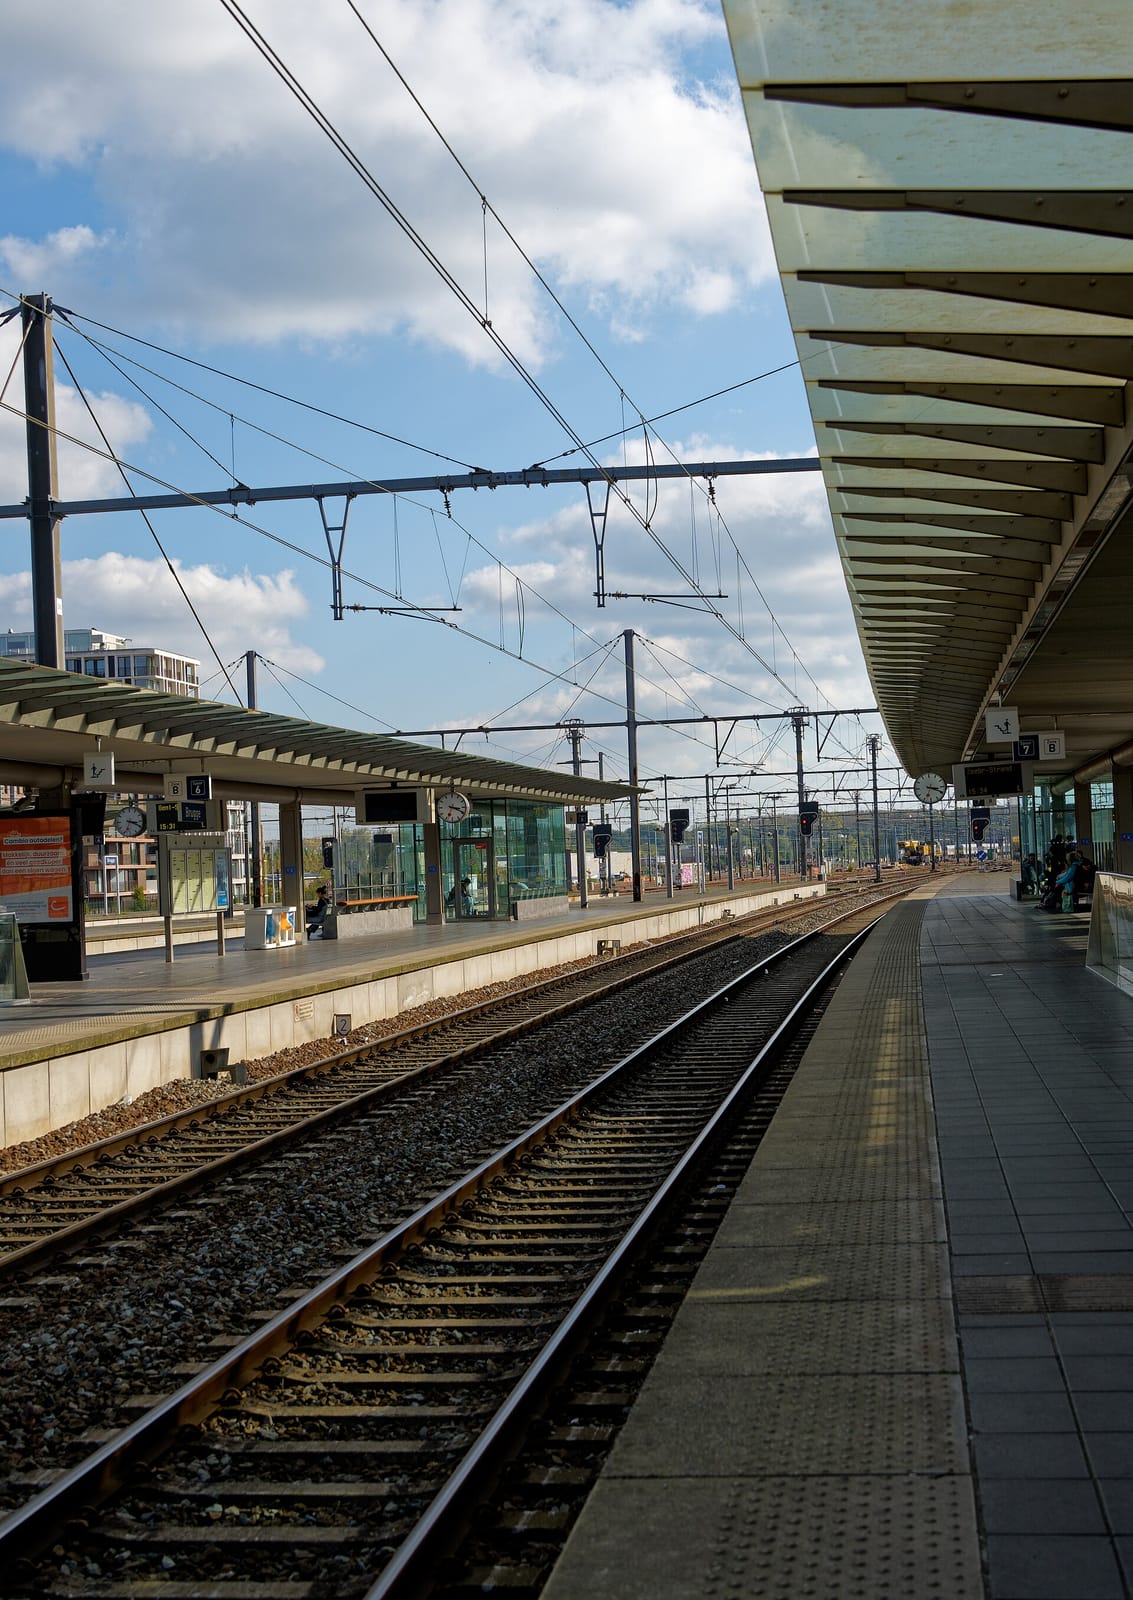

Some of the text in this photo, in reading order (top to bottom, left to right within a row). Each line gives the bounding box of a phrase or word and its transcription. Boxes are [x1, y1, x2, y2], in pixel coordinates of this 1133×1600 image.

[1023, 745, 1029, 755] 7
[172, 786, 179, 794] B
[195, 785, 201, 794] 6
[185, 806, 201, 820] Brugge
[340, 1019, 346, 1031] 2
